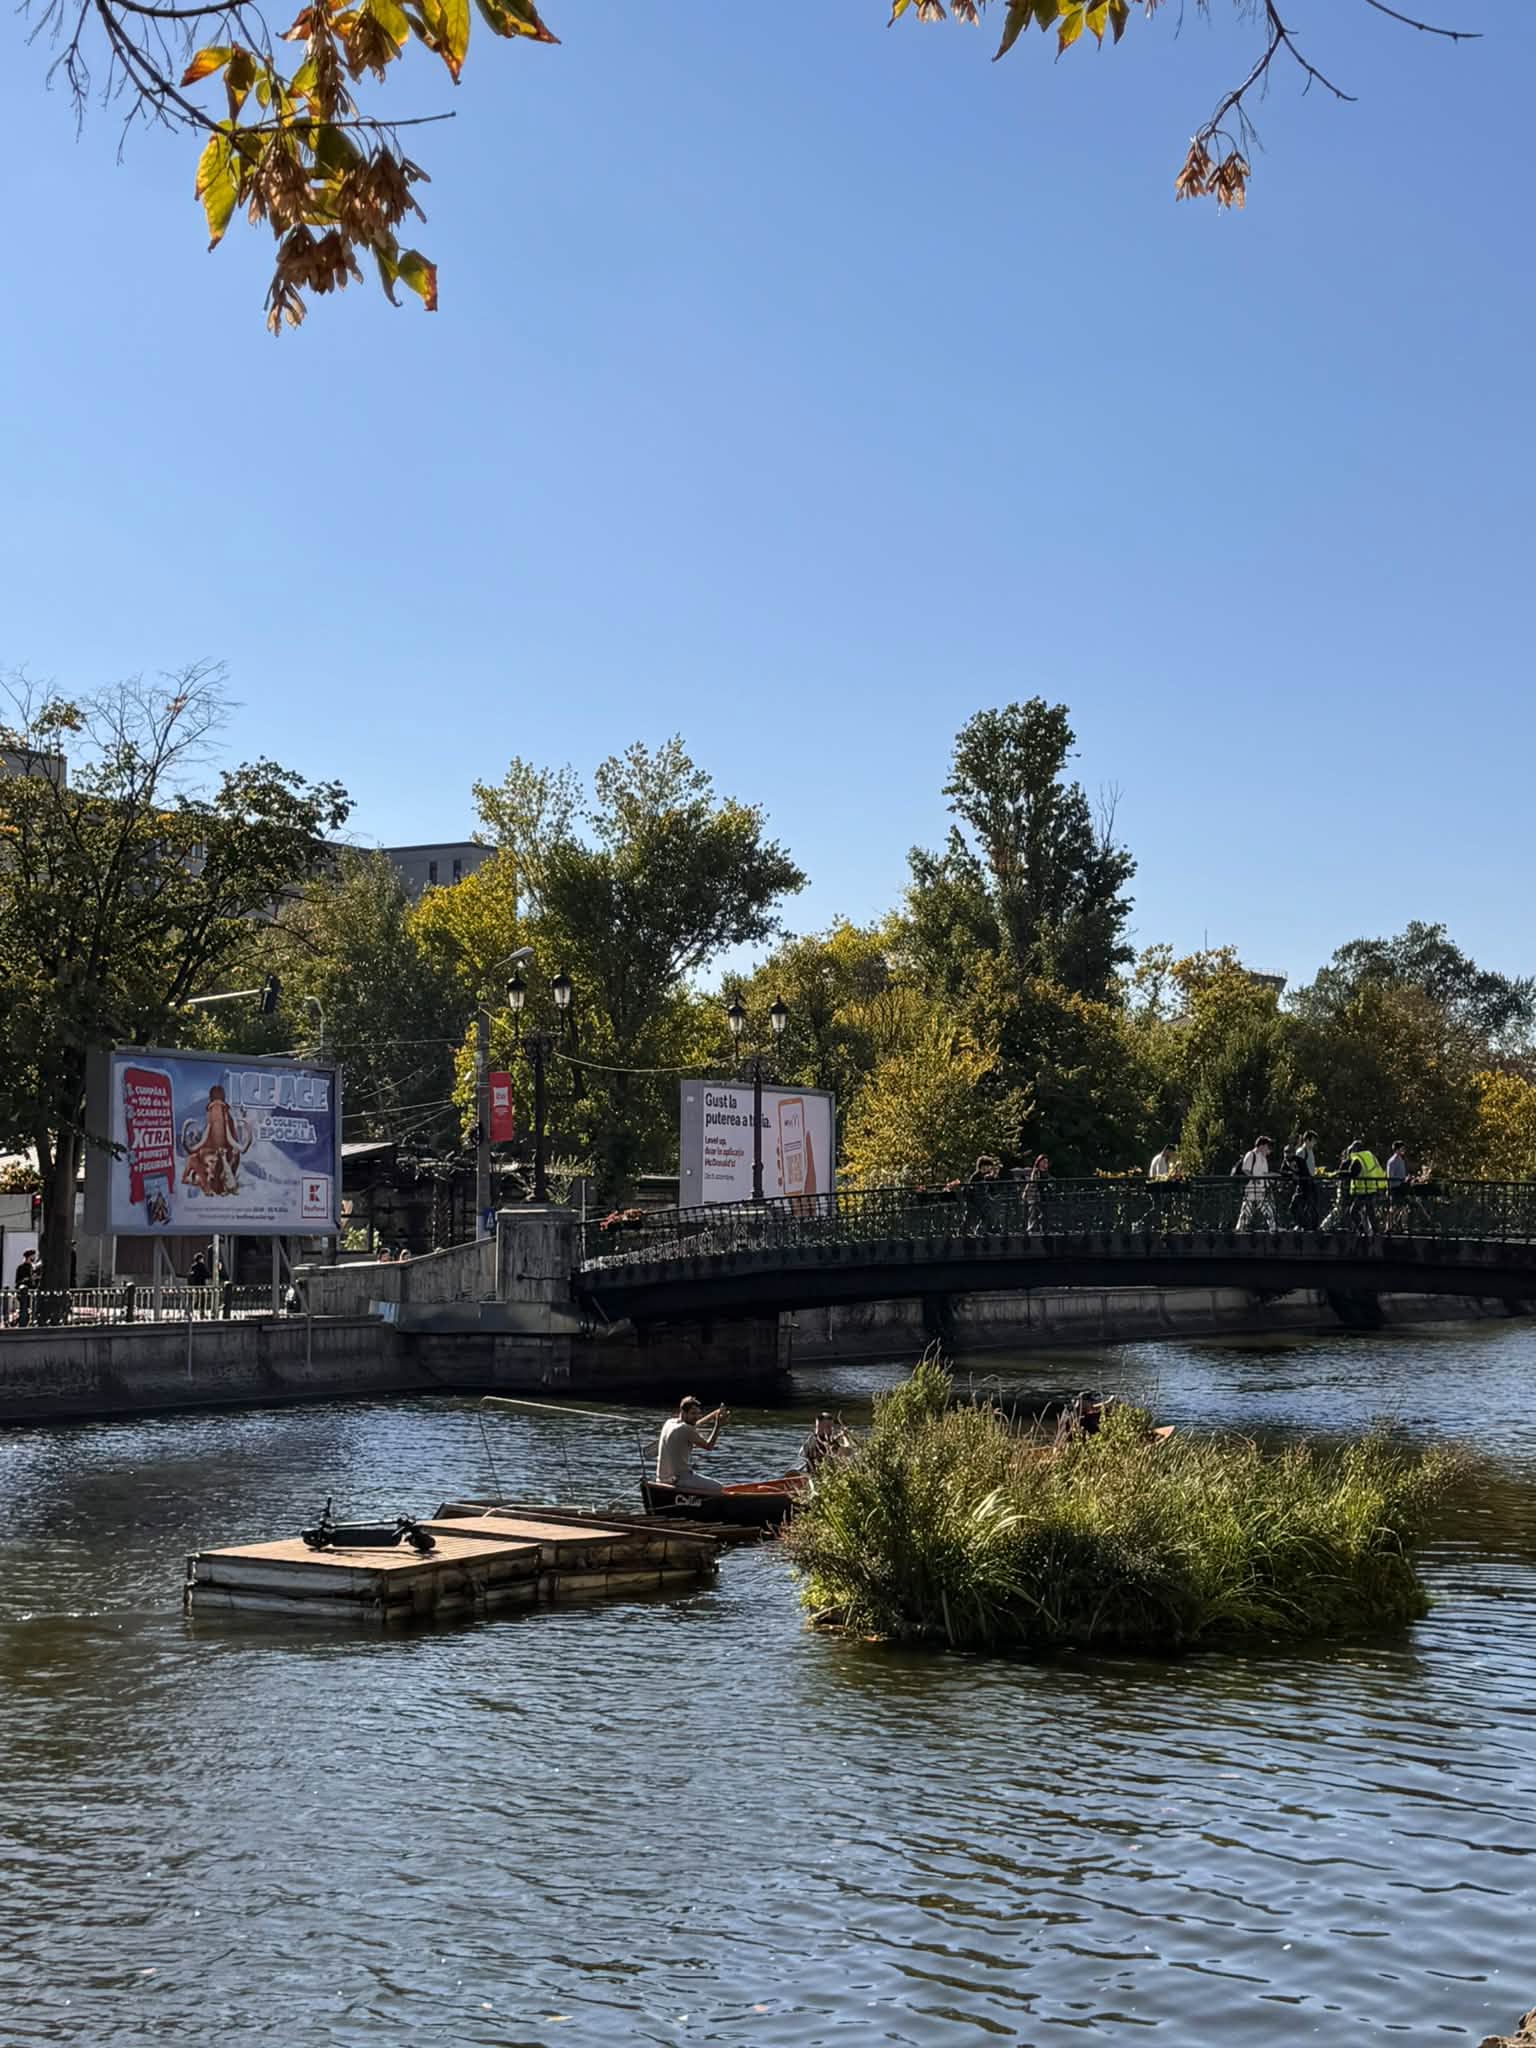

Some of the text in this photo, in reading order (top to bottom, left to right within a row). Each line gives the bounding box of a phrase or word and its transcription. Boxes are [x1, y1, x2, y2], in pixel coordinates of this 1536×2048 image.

[225, 1072, 330, 1111] ICE AGE
[705, 1092, 737, 1109] Gust la
[264, 1117, 272, 1126] O
[705, 1112, 741, 1128] puterea
[742, 1116, 748, 1127] a
[132, 1128, 172, 1150] XTRA
[259, 1127, 315, 1142] EPOCALĂ
